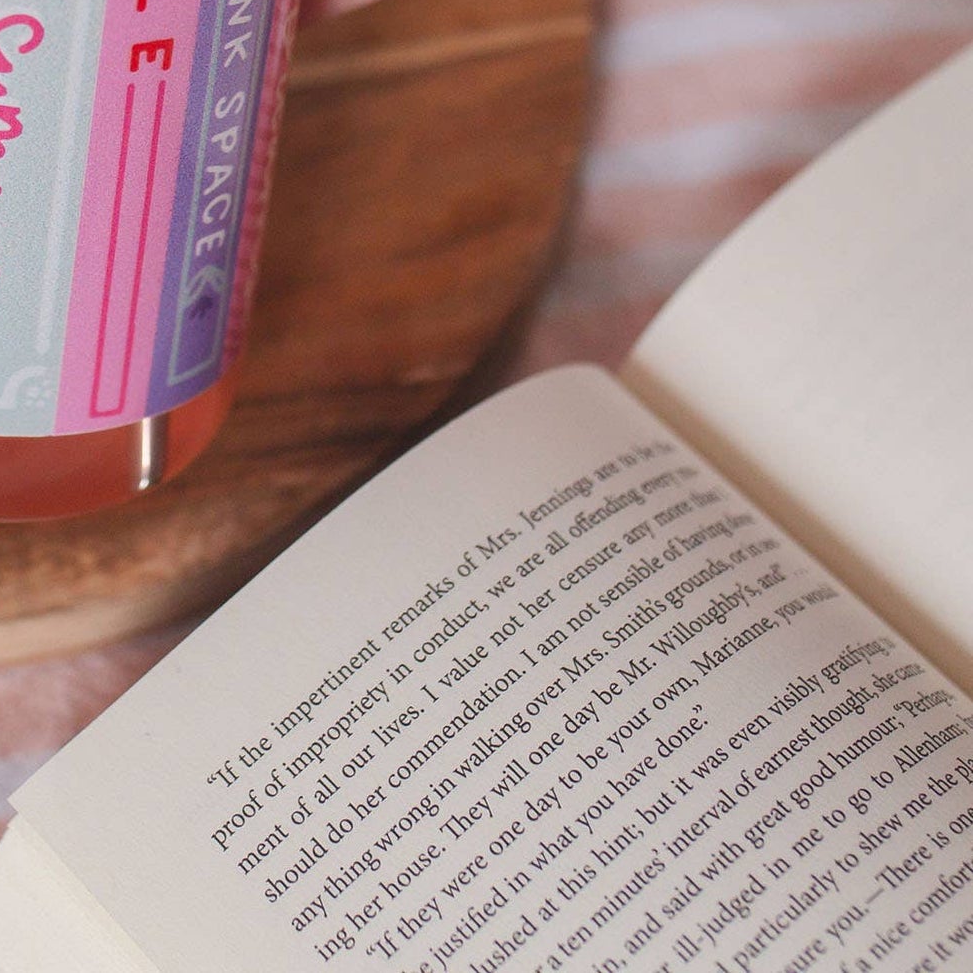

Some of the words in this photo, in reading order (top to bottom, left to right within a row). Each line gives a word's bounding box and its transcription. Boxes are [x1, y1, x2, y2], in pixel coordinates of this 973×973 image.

[194, 90, 247, 259] SPACE
[210, 788, 264, 852] proof
[264, 768, 287, 798] of
[282, 680, 390, 779] impropriety
[385, 663, 413, 685] in
[413, 600, 490, 663] conduct,
[486, 575, 516, 598] we
[515, 552, 545, 578] are
[544, 530, 570, 556] all
[568, 488, 647, 538] offending
[237, 824, 289, 875] ment
[290, 795, 313, 825] of
[313, 773, 341, 804] all
[341, 744, 376, 778] our
[370, 705, 425, 747] lives.
[419, 684, 440, 703] I
[437, 645, 489, 688] value
[489, 615, 525, 647] not
[517, 588, 556, 619] her
[558, 541, 622, 591] censure
[622, 520, 656, 545] any
[238, 737, 273, 768] the
[270, 639, 381, 738] impertinent
[381, 576, 455, 642] remarks
[456, 550, 479, 577] of
[474, 527, 522, 560] Mrs.
[517, 476, 594, 530] Jennings
[264, 836, 329, 903] should
[325, 818, 354, 844] do
[347, 785, 387, 821] her
[387, 668, 526, 788] commendation.
[519, 648, 539, 667] I
[536, 629, 569, 656] am
[565, 602, 601, 633] not
[598, 556, 665, 608] sensible
[662, 538, 683, 562] of
[291, 894, 328, 932] any
[323, 848, 381, 899] thing
[373, 794, 440, 852] wrong
[452, 711, 532, 778] walking
[525, 677, 567, 716] over
[559, 648, 609, 684] Mrs.
[601, 598, 667, 649] Smith’s
[664, 558, 735, 609] grounds,
[313, 927, 356, 962] ing
[344, 895, 384, 932] her
[378, 844, 446, 900] house.
[438, 795, 493, 840] They
[489, 758, 530, 797] will
[528, 732, 565, 765] one
[562, 700, 600, 734] day
[590, 682, 623, 705] be
[616, 656, 657, 686] Mr.
[396, 896, 443, 940] they
[440, 855, 488, 898] were
[488, 820, 525, 856] one
[523, 786, 562, 822] day
[558, 769, 583, 790] to
[575, 745, 609, 770] be
[606, 707, 652, 753] your
[652, 676, 699, 710] own,
[690, 617, 780, 677] Marianne,
[773, 599, 806, 625] you
[429, 886, 509, 973] justified
[503, 871, 532, 894] in
[528, 825, 579, 871] what
[574, 794, 615, 835] you
[606, 755, 658, 797] have
[537, 898, 560, 922] at
[556, 864, 597, 901] this
[589, 823, 644, 867] hint;
[634, 791, 677, 825] but
[670, 776, 694, 796] it
[690, 747, 729, 779] was
[728, 714, 772, 750] even
[767, 674, 825, 716] visibly
[547, 955, 563, 972] a
[556, 925, 593, 957] ten
[662, 788, 738, 858] interval
[734, 769, 757, 797] of
[754, 727, 817, 781] earnest
[809, 686, 880, 734] thought,
[871, 673, 899, 693] she
[623, 911, 664, 955] and
[661, 874, 703, 920] said
[699, 841, 746, 881] with
[743, 799, 792, 850] great
[789, 759, 837, 810] good
[826, 715, 905, 770] humour;
[672, 873, 767, 963] ill-judged
[762, 857, 792, 880] in
[791, 828, 824, 857] me
[821, 809, 846, 829] to
[847, 788, 872, 815] go
[870, 770, 894, 789] to
[892, 715, 969, 774] Allenham;
[732, 869, 840, 973] particularly
[834, 853, 859, 873] to
[858, 813, 903, 855] shew
[901, 792, 932, 819] me
[926, 773, 958, 797] the
[926, 831, 950, 850] is
[868, 921, 911, 961] nice
[908, 861, 973, 925] comfort
